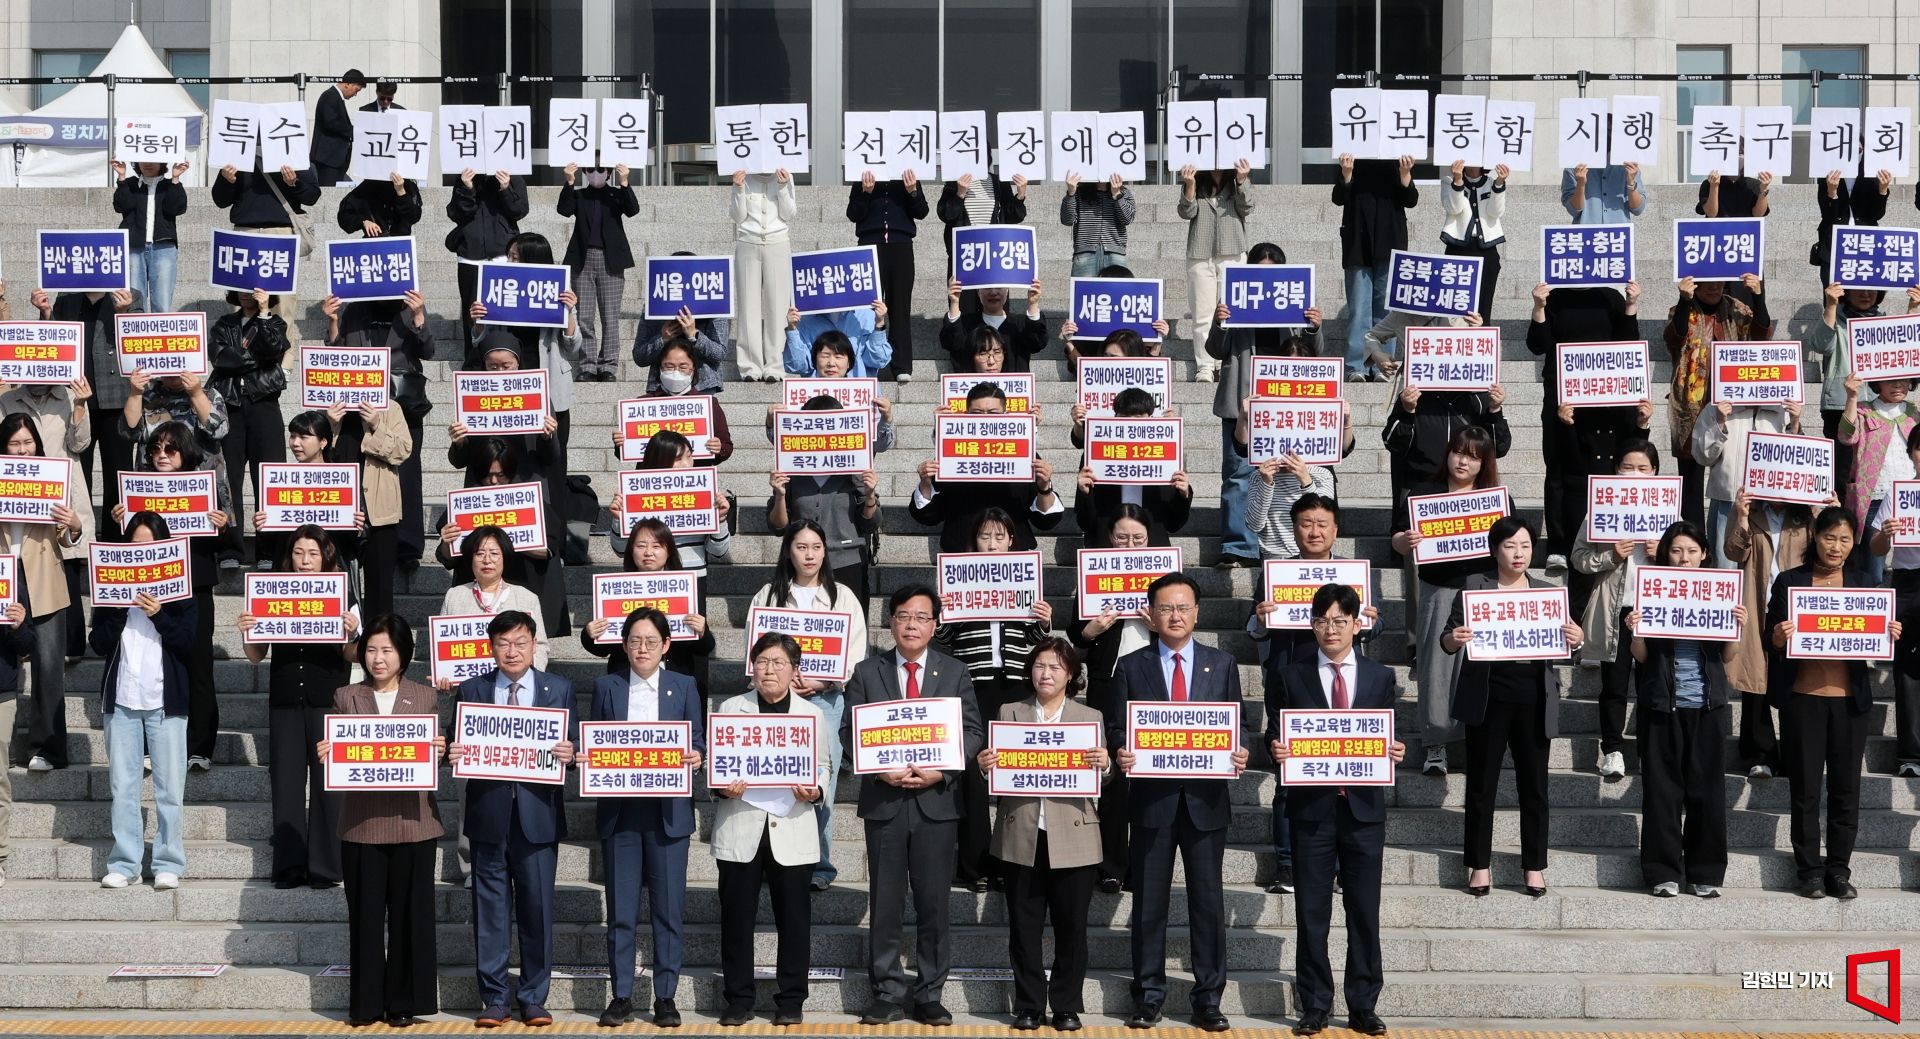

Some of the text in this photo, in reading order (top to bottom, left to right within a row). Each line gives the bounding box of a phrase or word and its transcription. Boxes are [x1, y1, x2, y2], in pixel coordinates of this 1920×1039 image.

[123, 134, 177, 154] 약동위
[1550, 231, 1626, 255] 충북·충남
[1684, 234, 1755, 264] 경기·강원
[1841, 233, 1915, 258] 전북·전남
[44, 245, 122, 274] 부산·울산·경남
[218, 245, 290, 278] 대구·경북
[960, 241, 1030, 271] 경기·강원
[333, 252, 411, 284] 부산·울산·경남
[1398, 259, 1474, 286] 충북·충남
[1550, 257, 1626, 280] 대전·세종
[1840, 259, 1915, 283] 광주·제주
[653, 271, 724, 301] 서울·인천
[795, 262, 873, 297] 부산·울산·경남
[486, 279, 559, 310] 서울·인천
[1231, 281, 1305, 310] 대구·경북
[1395, 283, 1471, 311] 대전·세종
[1079, 294, 1153, 323] 서울·인천
[38, 328, 77, 341] 장애유아
[122, 319, 198, 334] 장애아어린이집에
[15, 346, 58, 360] 의무교육
[123, 337, 198, 354] 행정업무 담당자
[1412, 337, 1494, 358] 보육-교육 지원 격차
[309, 353, 381, 367] 장애영유아교사
[1564, 350, 1644, 371] 장애아어린이집도
[1718, 348, 1797, 362] 차별없는 장애유아
[1, 365, 72, 378] 즉각 시행하라!
[308, 372, 383, 386] 근무여건 유-보 격차
[1411, 363, 1494, 382] 즉각 해소하라!!
[1737, 366, 1780, 380] 의무교육
[1565, 376, 1645, 397] 법적 의무교육기관이다!
[1723, 384, 1794, 399] 즉각 시행하라!
[307, 390, 335, 403] 조속히
[946, 422, 1027, 437] 교사 대 장애영유아
[1094, 425, 1174, 440] 교사 대 장애영유아
[954, 441, 1016, 455] 비율 1:2로
[1103, 444, 1165, 459] 비율 1:2로
[3, 463, 40, 477] 교육부
[956, 461, 1015, 476] 조정하라!!
[1105, 464, 1163, 478] 조정하라!!
[269, 470, 349, 485] 교사 대 장애영유아
[45, 483, 62, 498] 부서
[278, 490, 340, 504] 비율 1:2로
[281, 509, 339, 523] 조정하라!!
[99, 545, 179, 563] 장애영유아교사
[99, 563, 182, 582] 근무여건 유-보 격차
[945, 562, 1035, 584] 장애아어린이집도
[98, 587, 132, 600] 조속히
[254, 580, 337, 595] 장애영유아교사
[1642, 578, 1735, 602] 보육-교육 지원 격차
[267, 600, 325, 616] 자격 전환
[1472, 600, 1562, 622] 보육-교육 지원 격차
[1796, 595, 1888, 611] 차별없는 장애유아
[1641, 606, 1734, 631] 즉각 해소하라!!
[1817, 616, 1865, 632] 의무교육
[254, 621, 338, 635] 조속히 해결하라!
[1473, 628, 1563, 650] 즉각 해소하라!!
[1800, 636, 1880, 652] 즉각 시행하라!
[886, 706, 927, 722] 교육부
[1137, 710, 1230, 726] 장애아어린이집에
[336, 723, 427, 739] 교사 대 장애영유아
[464, 714, 559, 740] 장애아어린이집도
[1290, 718, 1384, 733] 특수교육법 개정!
[592, 730, 679, 745] 장애영유아교사
[715, 725, 810, 748] 보육-교육 지원 격차
[861, 725, 932, 745] 장애영유아전담
[1024, 731, 1065, 745] 교육부
[1138, 731, 1229, 748] 행정업무 담당자
[346, 745, 416, 761] 비율 1:2로
[1291, 740, 1384, 756] 장애영유아 유보통합
[591, 751, 681, 767] 근무여건 유-보 격차
[877, 748, 941, 765] 설치하라!!
[997, 751, 1068, 767] 장애영유아전담
[1152, 754, 1213, 770] 배치하라!
[715, 755, 810, 777] 즉각 해소하라!!
[1302, 762, 1373, 777] 즉각 시행!!
[348, 767, 414, 782] 조정하라!!
[589, 773, 683, 788] 조속히 해결하라!
[1012, 773, 1077, 788] 설치하라!!
